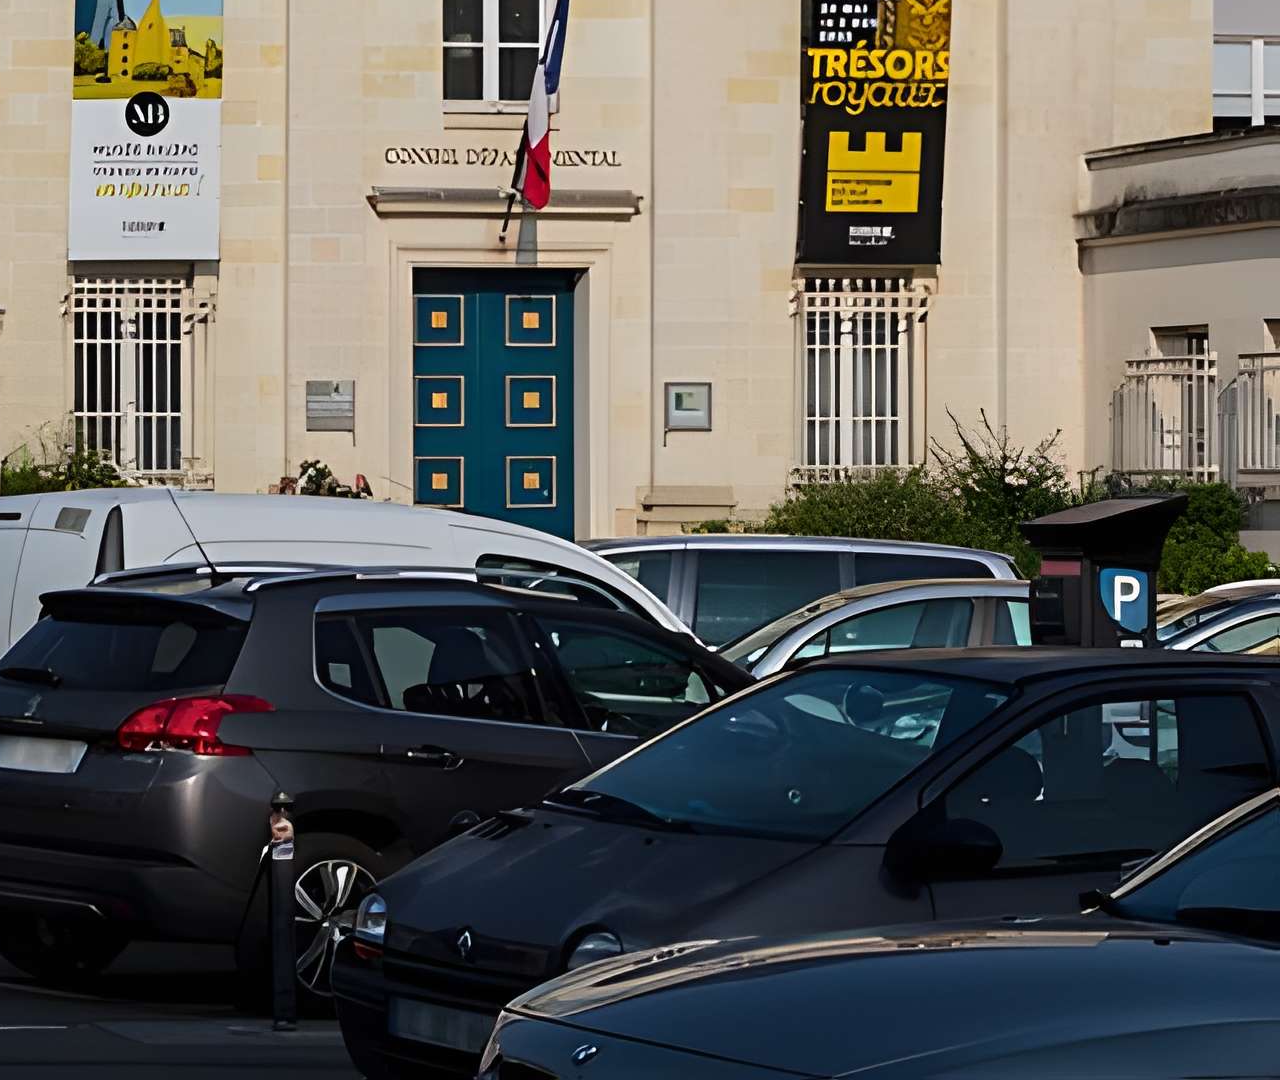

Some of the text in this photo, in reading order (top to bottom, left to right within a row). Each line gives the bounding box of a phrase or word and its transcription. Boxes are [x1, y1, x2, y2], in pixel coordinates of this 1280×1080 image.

[808, 39, 950, 81] TRÉSORS
[809, 80, 946, 116] royaux
[1114, 575, 1140, 621] P
